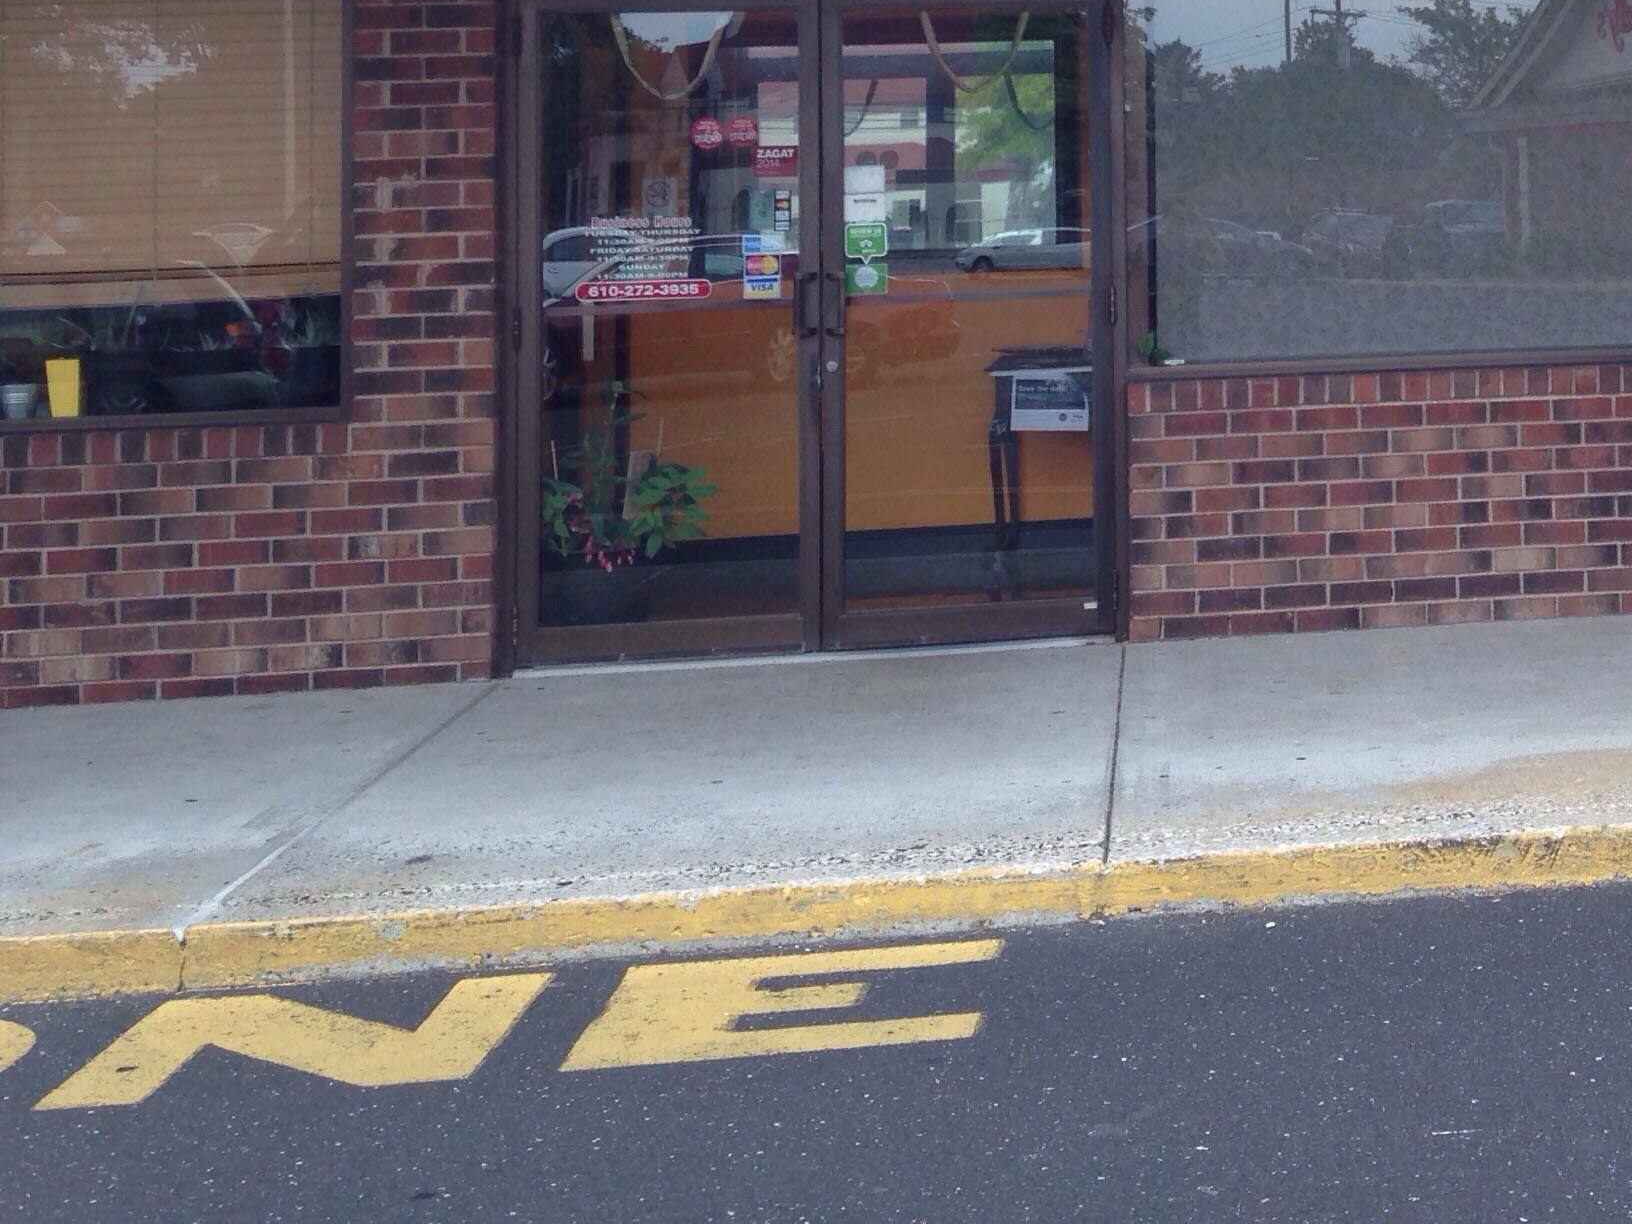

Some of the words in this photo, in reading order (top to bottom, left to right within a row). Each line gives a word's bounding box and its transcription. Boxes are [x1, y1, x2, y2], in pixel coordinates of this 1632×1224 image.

[756, 149, 795, 158] ZAGAT
[756, 159, 780, 168] 2014
[590, 216, 650, 229] Business
[653, 215, 692, 228] Hours
[618, 263, 665, 271] SUNDAY
[588, 283, 700, 297] 610-272-3935
[752, 282, 774, 291] VISA
[0, 939, 1003, 1111] NE
